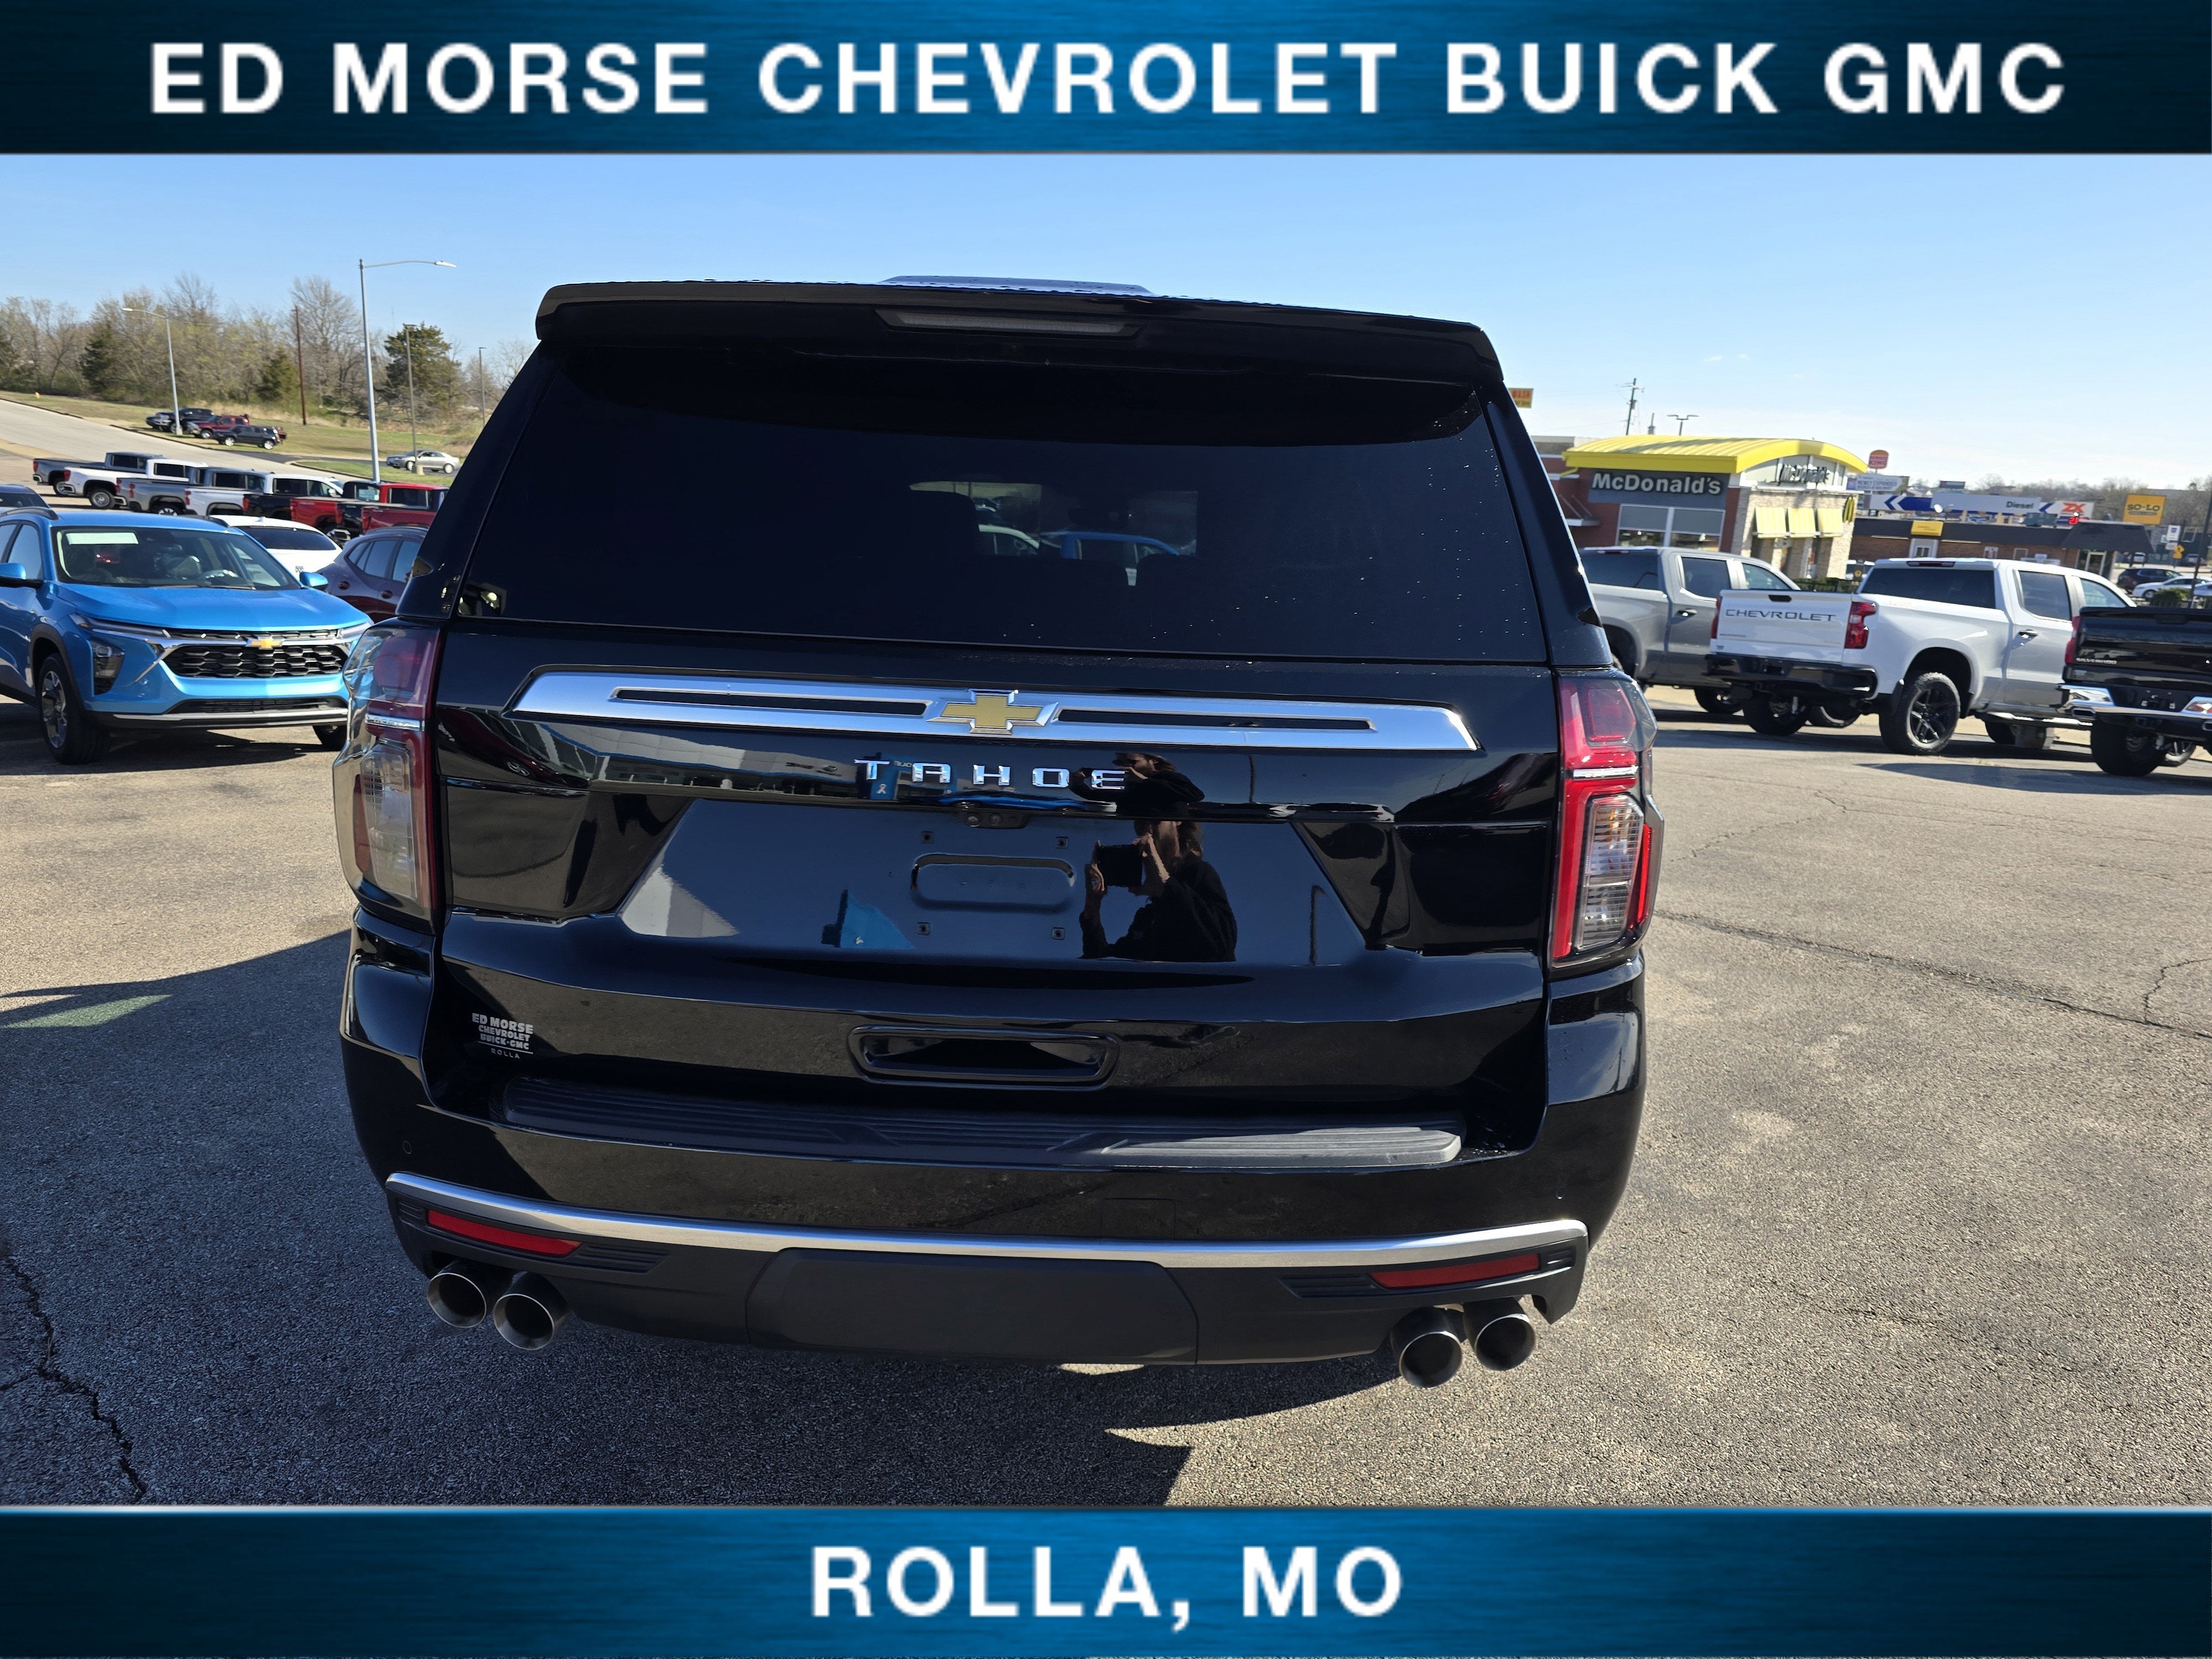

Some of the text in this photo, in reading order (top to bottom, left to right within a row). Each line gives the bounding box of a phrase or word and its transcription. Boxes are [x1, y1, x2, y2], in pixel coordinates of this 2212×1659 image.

[1592, 473, 1721, 494] McDonald's
[2006, 501, 2034, 509] Diesel
[1725, 609, 1837, 622] CHEVROLET
[854, 759, 1126, 791] TAHOE
[472, 1013, 534, 1035] ED MORSE
[478, 1025, 530, 1041] CHEVROLET
[491, 1048, 520, 1059] ROLLA
